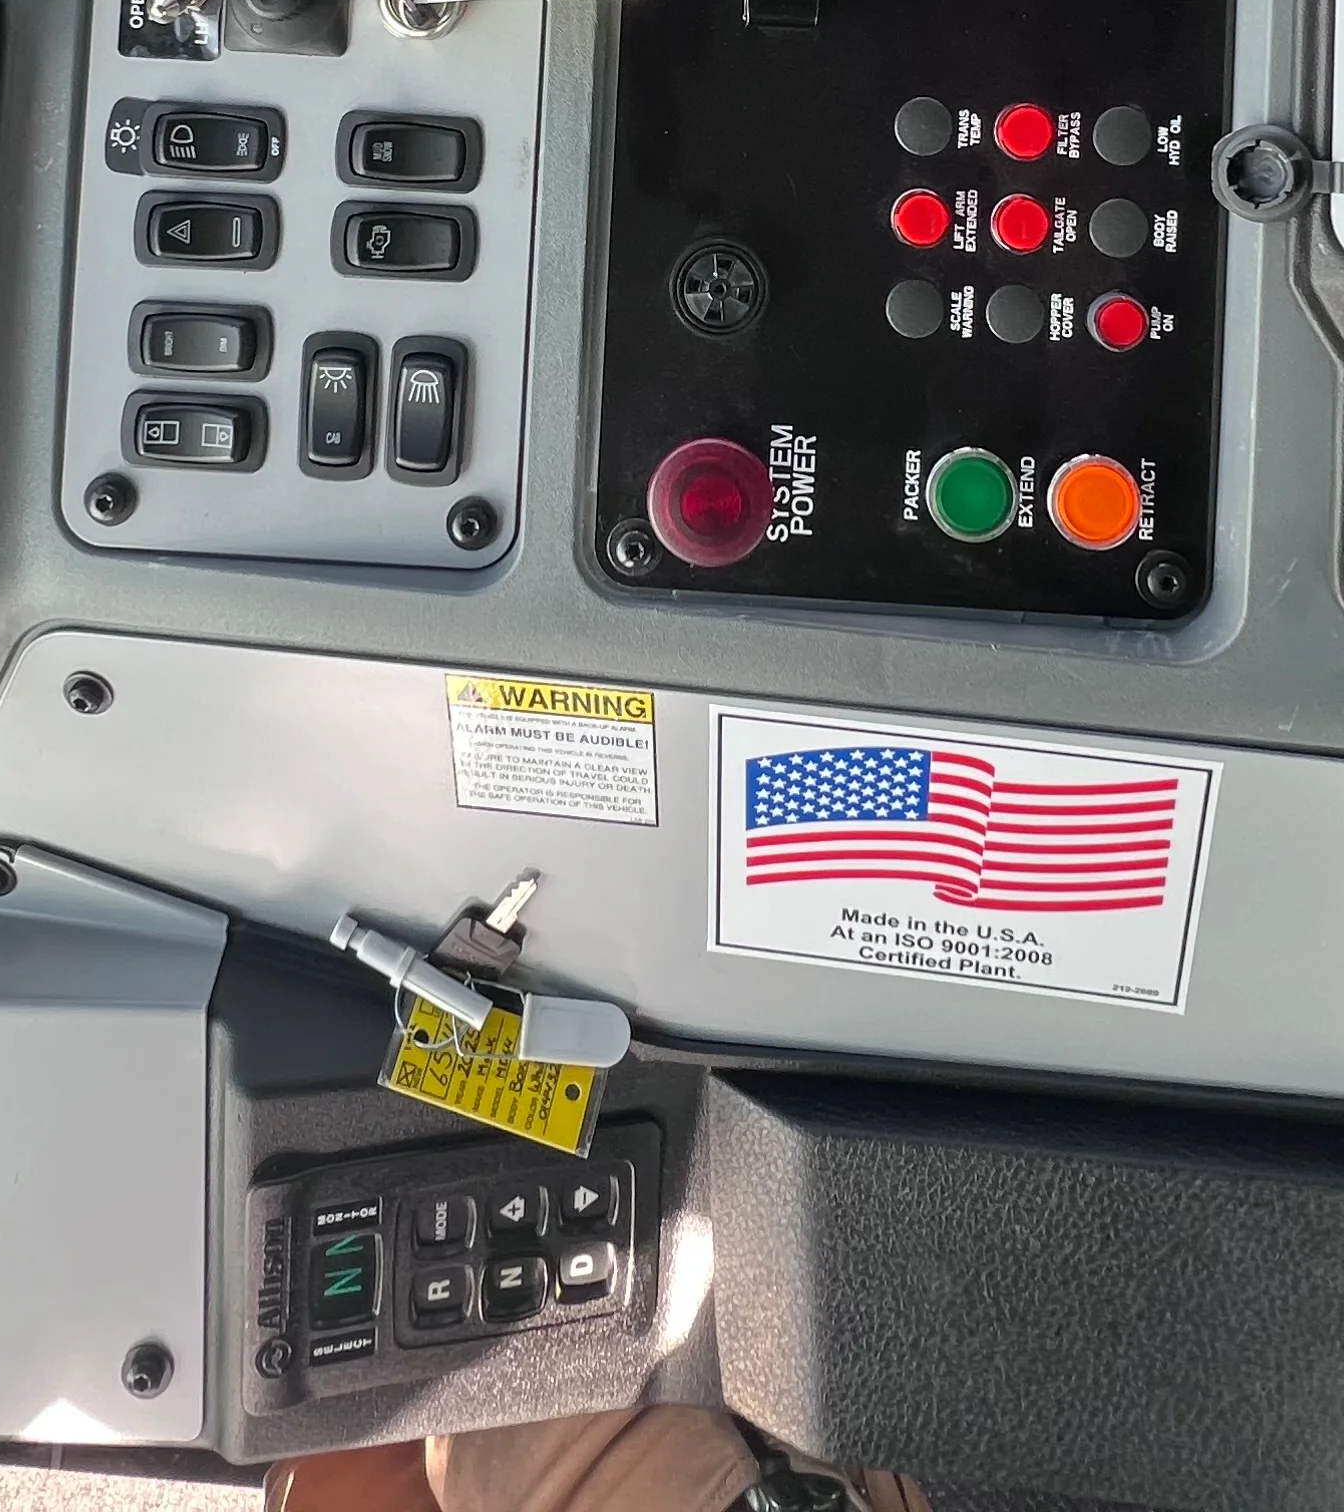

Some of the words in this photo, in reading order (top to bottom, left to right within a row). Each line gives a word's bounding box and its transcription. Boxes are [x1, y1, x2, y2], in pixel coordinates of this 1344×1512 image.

[958, 110, 970, 148] TRANS
[970, 113, 981, 146] TEMP
[1057, 114, 1069, 155] FILTER
[1069, 111, 1081, 159] BYPASS
[1157, 127, 1168, 152] LOW
[1170, 115, 1181, 134] OIL
[271, 137, 279, 156] OFF
[383, 141, 393, 162] SNOW
[1169, 141, 1180, 165] HYD
[955, 191, 966, 217] ARM
[965, 189, 978, 252] EXTENDED
[954, 223, 965, 249] LIFT
[1053, 197, 1065, 253] TAILGATE
[1066, 209, 1077, 243] OPEN
[1154, 214, 1165, 247] BODY
[1165, 210, 1177, 253] RAISED
[951, 292, 962, 331] SCALE
[962, 286, 974, 338] WARNING
[1050, 294, 1061, 341] HOPPER
[1061, 298, 1074, 338] COVER
[1151, 307, 1161, 339] PUMP
[1163, 314, 1174, 332] ON
[768, 424, 793, 542] SYSTEM
[791, 435, 816, 536] POWER
[904, 450, 921, 520] PACKER
[1019, 456, 1035, 528] EXTEND
[1140, 458, 1156, 541] RETRACT
[499, 684, 647, 719] WARNING
[456, 722, 506, 736] ALARM
[510, 728, 550, 741] MUST
[556, 733, 575, 742] BE
[579, 735, 650, 750] AUDIBLE!
[829, 924, 856, 943] At
[861, 929, 888, 946] an
[894, 931, 934, 951] ISO
[940, 935, 1054, 966] 9001:2008
[841, 908, 900, 930] Made
[907, 916, 927, 934] in
[934, 920, 969, 939] the
[976, 926, 1045, 948] U.S.A.
[858, 945, 953, 971] Certified
[958, 958, 1022, 981] Plant.
[317, 1206, 377, 1226] MONITOR
[434, 1201, 448, 1240] MODE
[257, 1216, 283, 1329] Allison
[323, 1267, 362, 1296] N
[499, 1266, 523, 1288] N
[570, 1254, 594, 1275] D
[427, 1280, 451, 1301] R
[313, 1339, 372, 1357] SELECT
